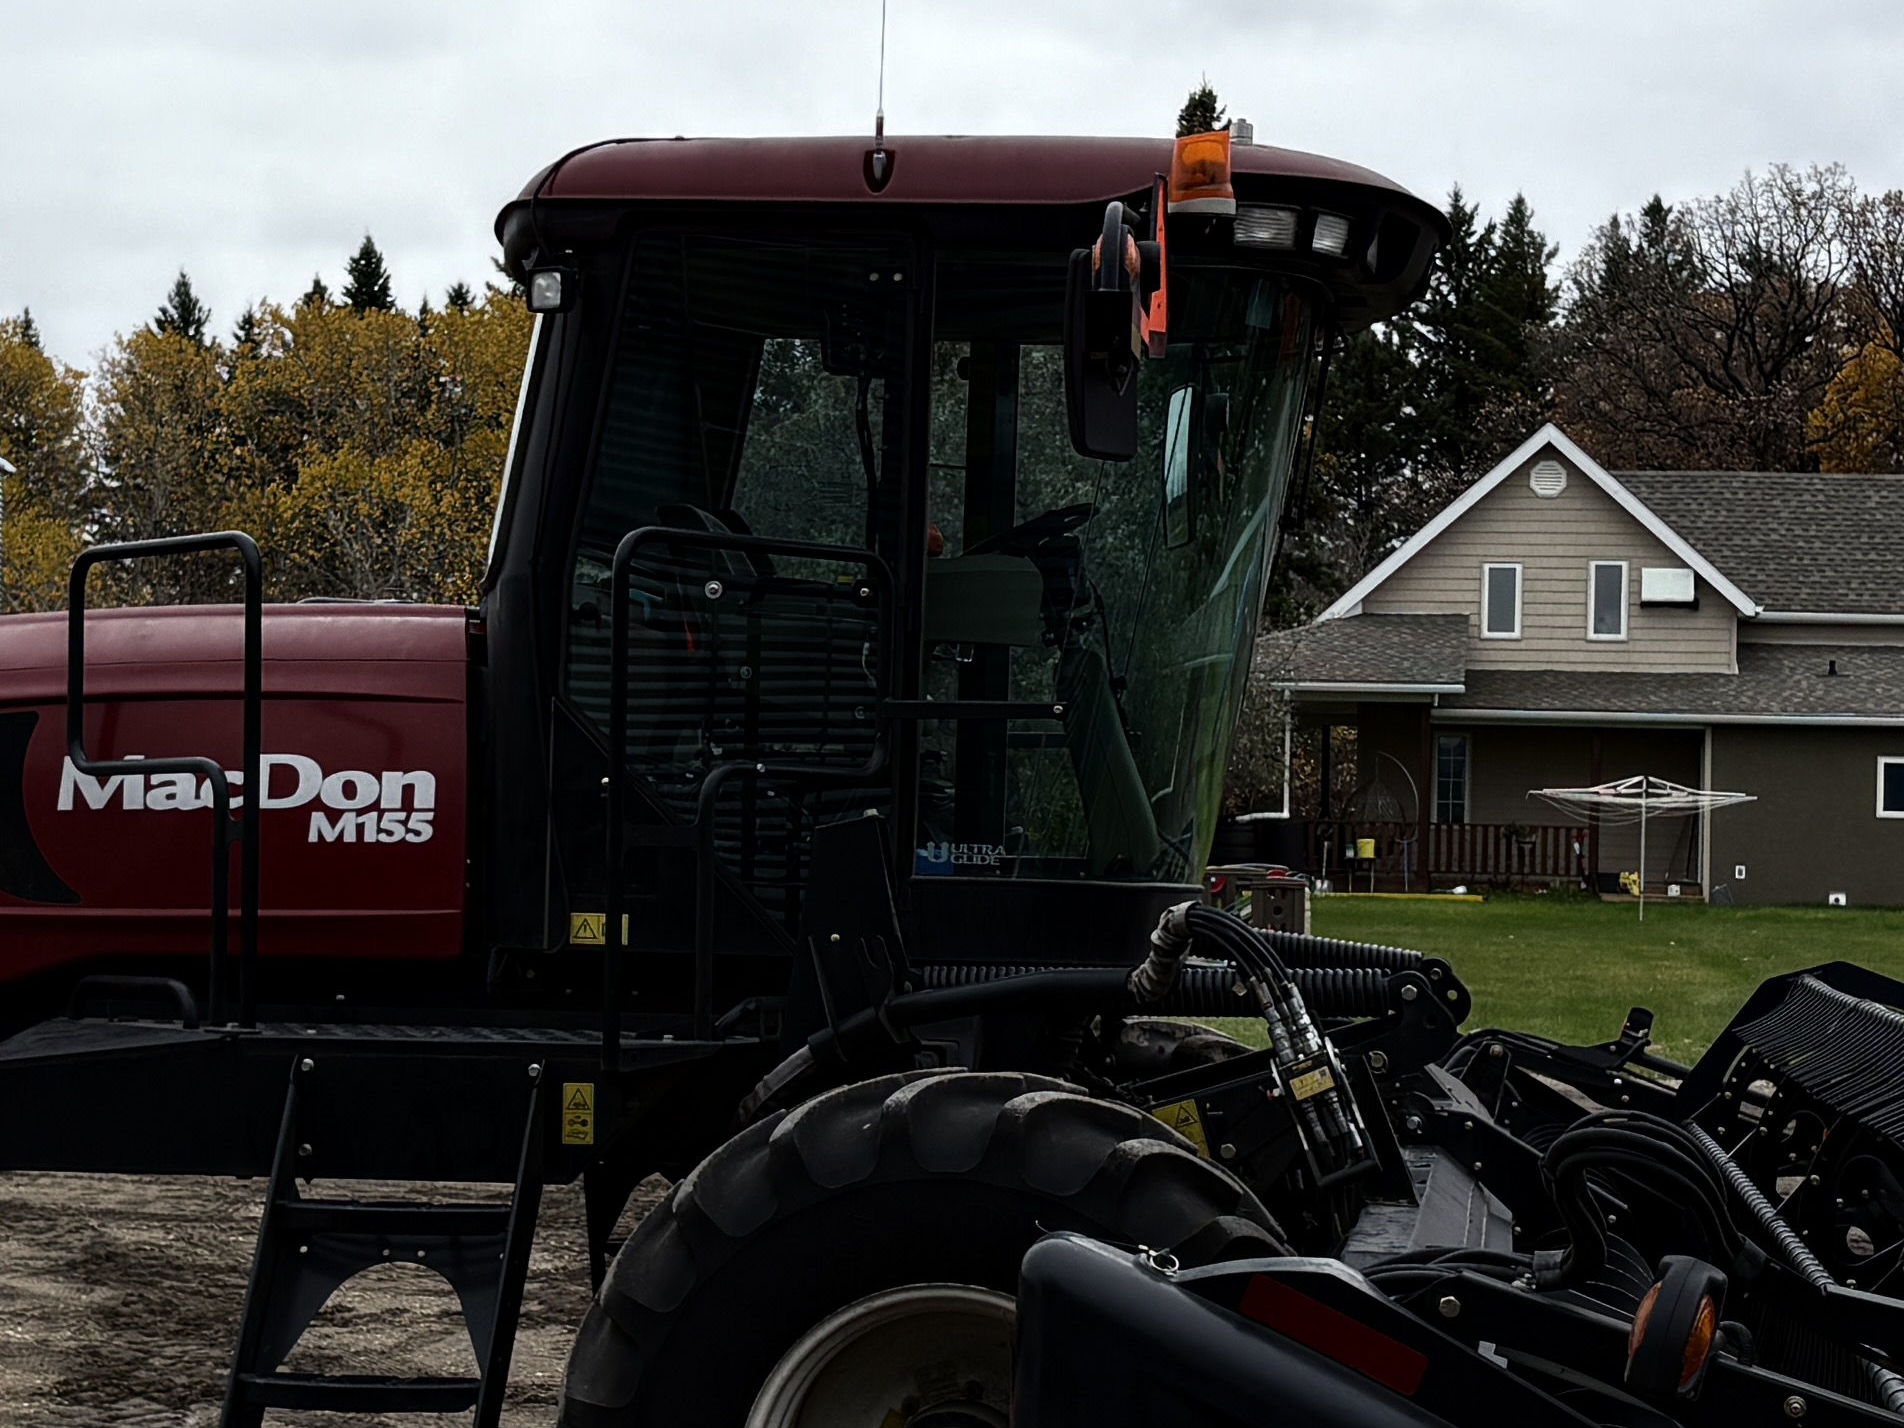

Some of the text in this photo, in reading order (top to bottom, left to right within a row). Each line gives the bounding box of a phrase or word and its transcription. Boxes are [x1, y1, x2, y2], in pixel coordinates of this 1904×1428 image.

[308, 811, 435, 844] M155
[950, 843, 1007, 856] ULTRA
[950, 853, 1001, 866] GLIDE
